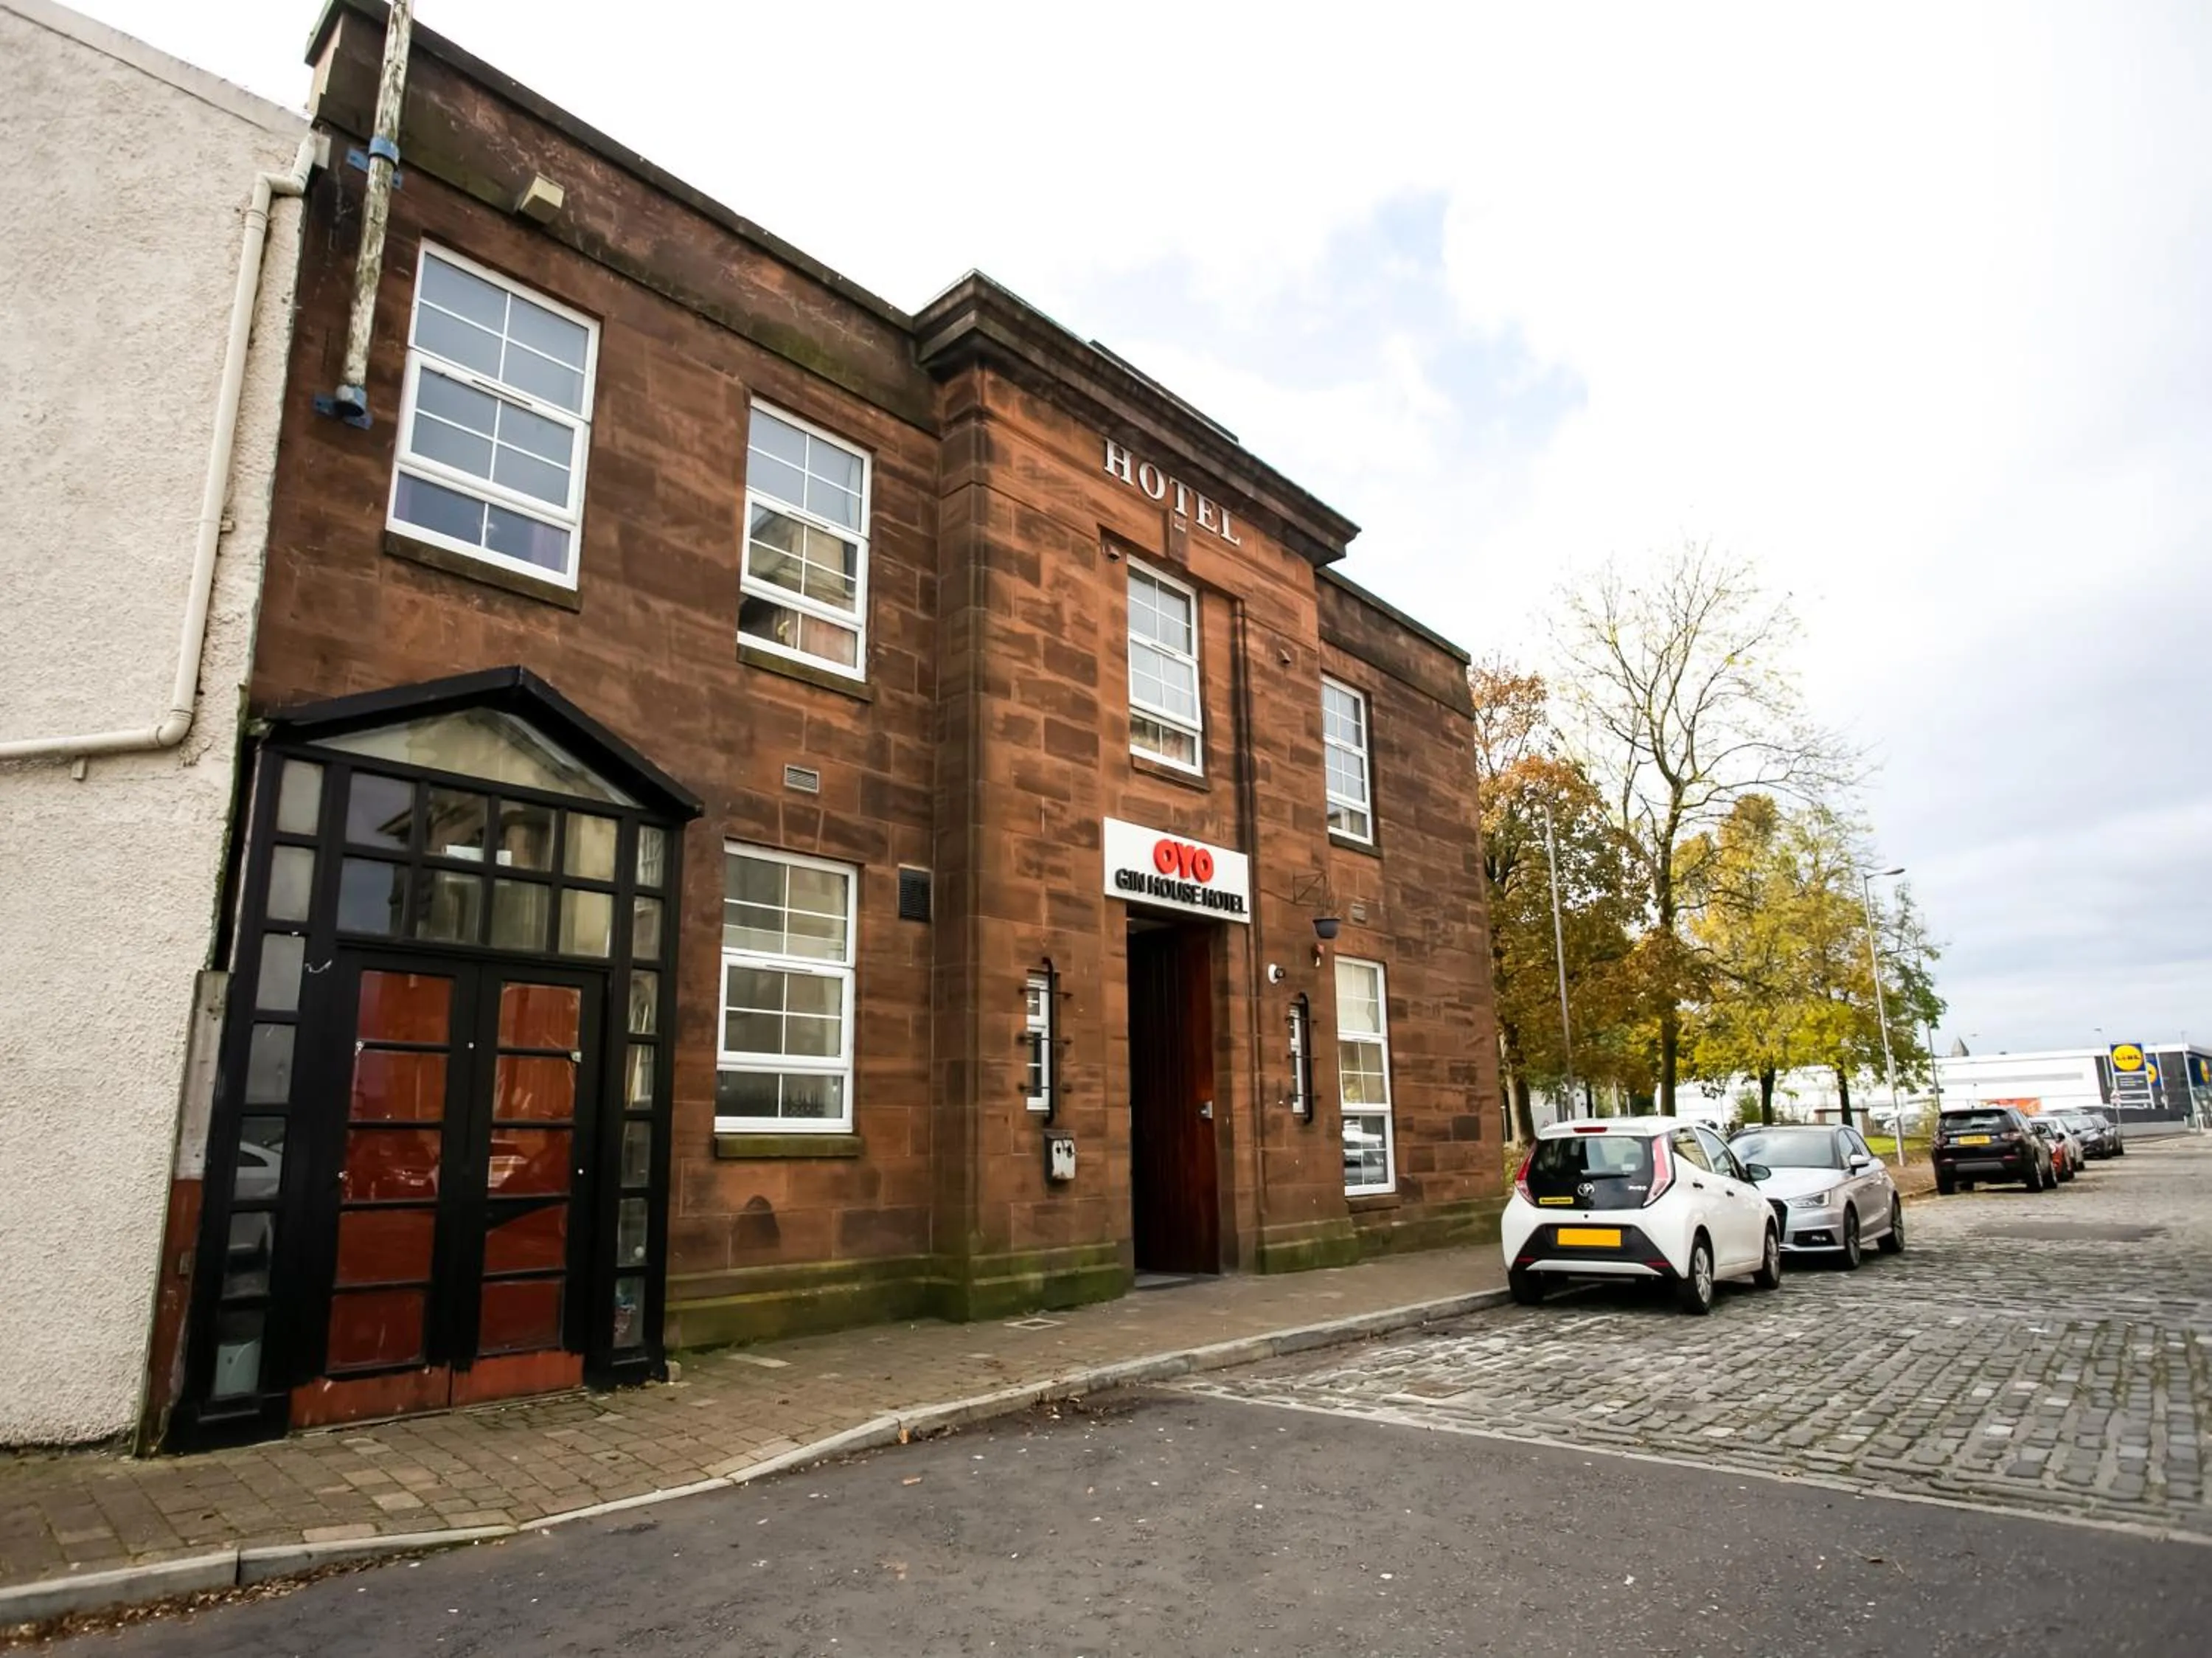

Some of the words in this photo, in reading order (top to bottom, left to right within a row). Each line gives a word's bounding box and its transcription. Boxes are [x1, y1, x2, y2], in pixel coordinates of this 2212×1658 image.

[1105, 440, 1240, 546] HOTEL
[1153, 839, 1214, 883] OYO
[1115, 868, 1146, 893] GIN
[1147, 874, 1201, 905] HOUSE
[1202, 887, 1248, 914] HOTEL
